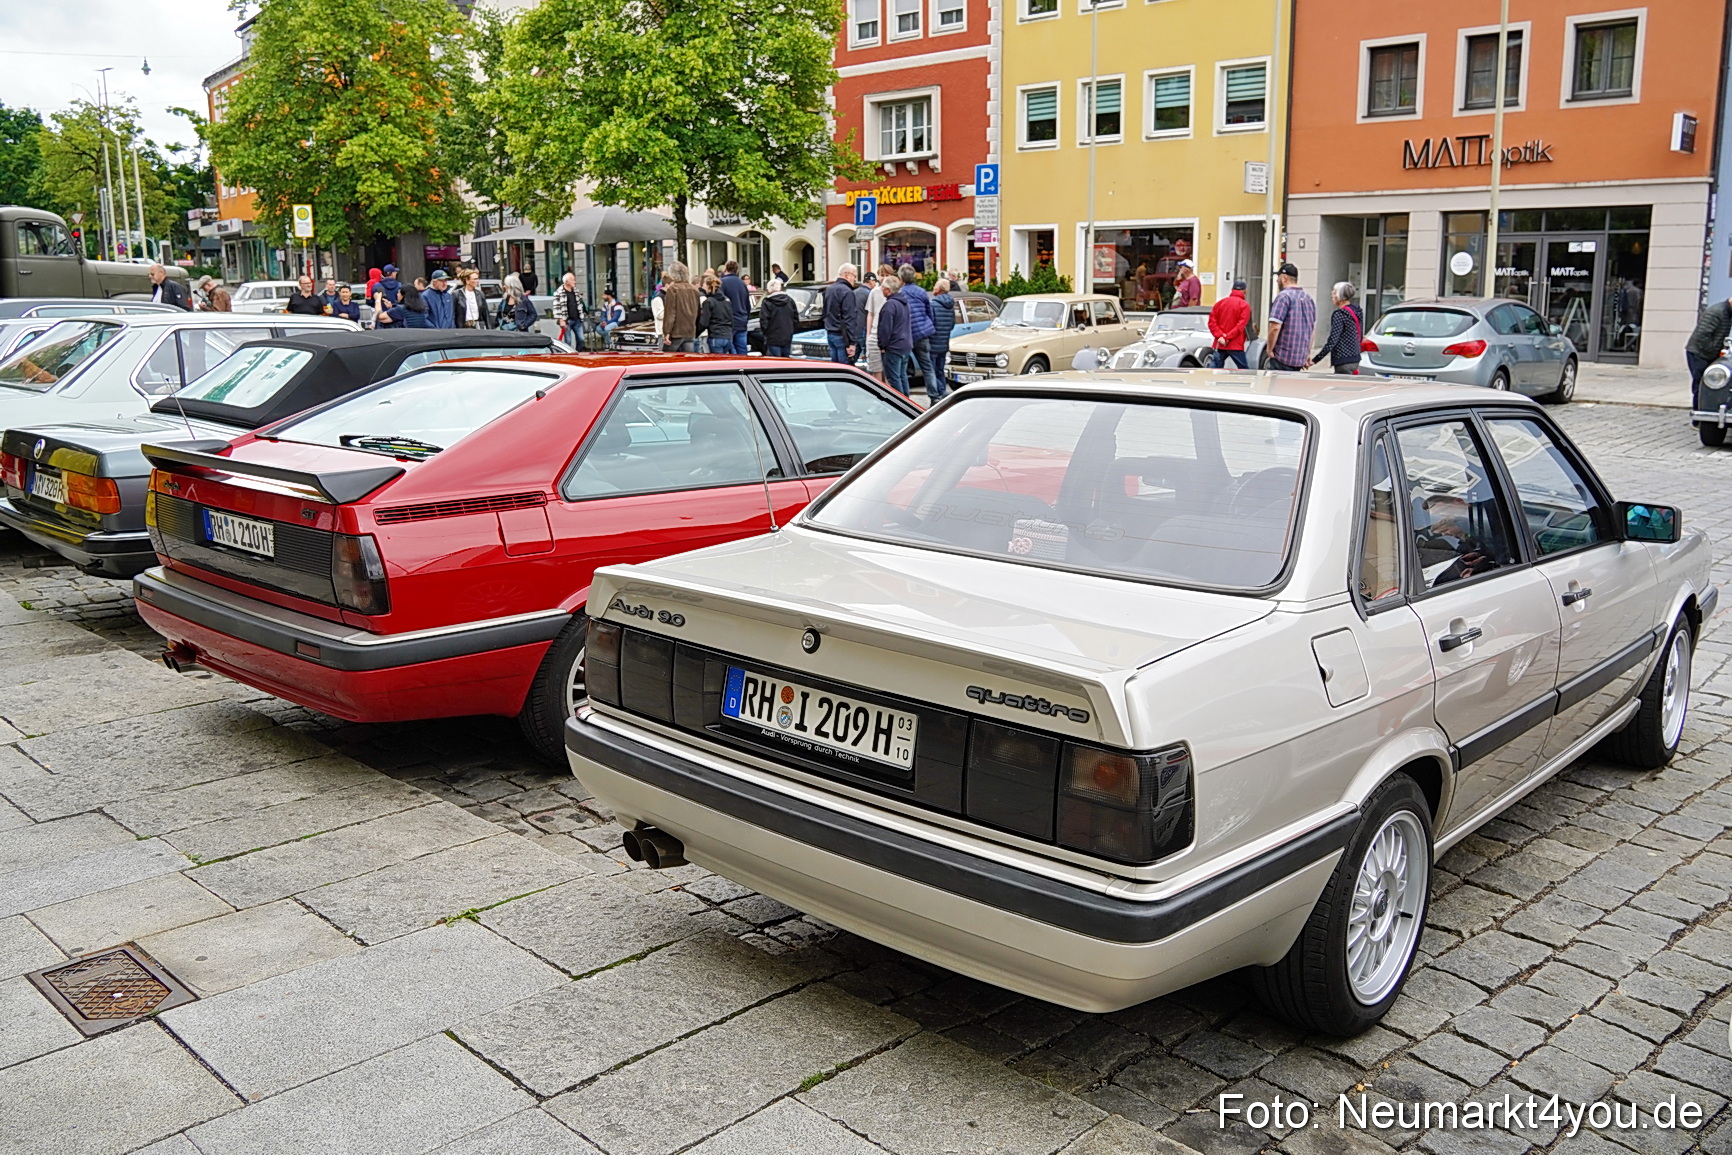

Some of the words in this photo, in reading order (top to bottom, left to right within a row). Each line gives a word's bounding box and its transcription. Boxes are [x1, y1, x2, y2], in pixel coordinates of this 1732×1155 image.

[981, 168, 994, 192] P
[873, 186, 923, 204] BÄCKER
[860, 201, 872, 222] P
[301, 508, 318, 520] GT
[914, 503, 1125, 542] quattro
[210, 514, 225, 541] RH
[608, 598, 654, 620] Audi
[657, 610, 686, 627] 90
[729, 697, 737, 708] D
[966, 685, 1090, 723] quattro
[741, 676, 777, 722] RH
[794, 691, 810, 732] I
[814, 697, 894, 756] 209H
[898, 716, 912, 731] 03
[761, 728, 776, 738] Audi
[780, 734, 812, 750] Vorsprung
[814, 744, 833, 756] durch
[834, 750, 860, 763] Technik
[896, 747, 909, 761] 10
